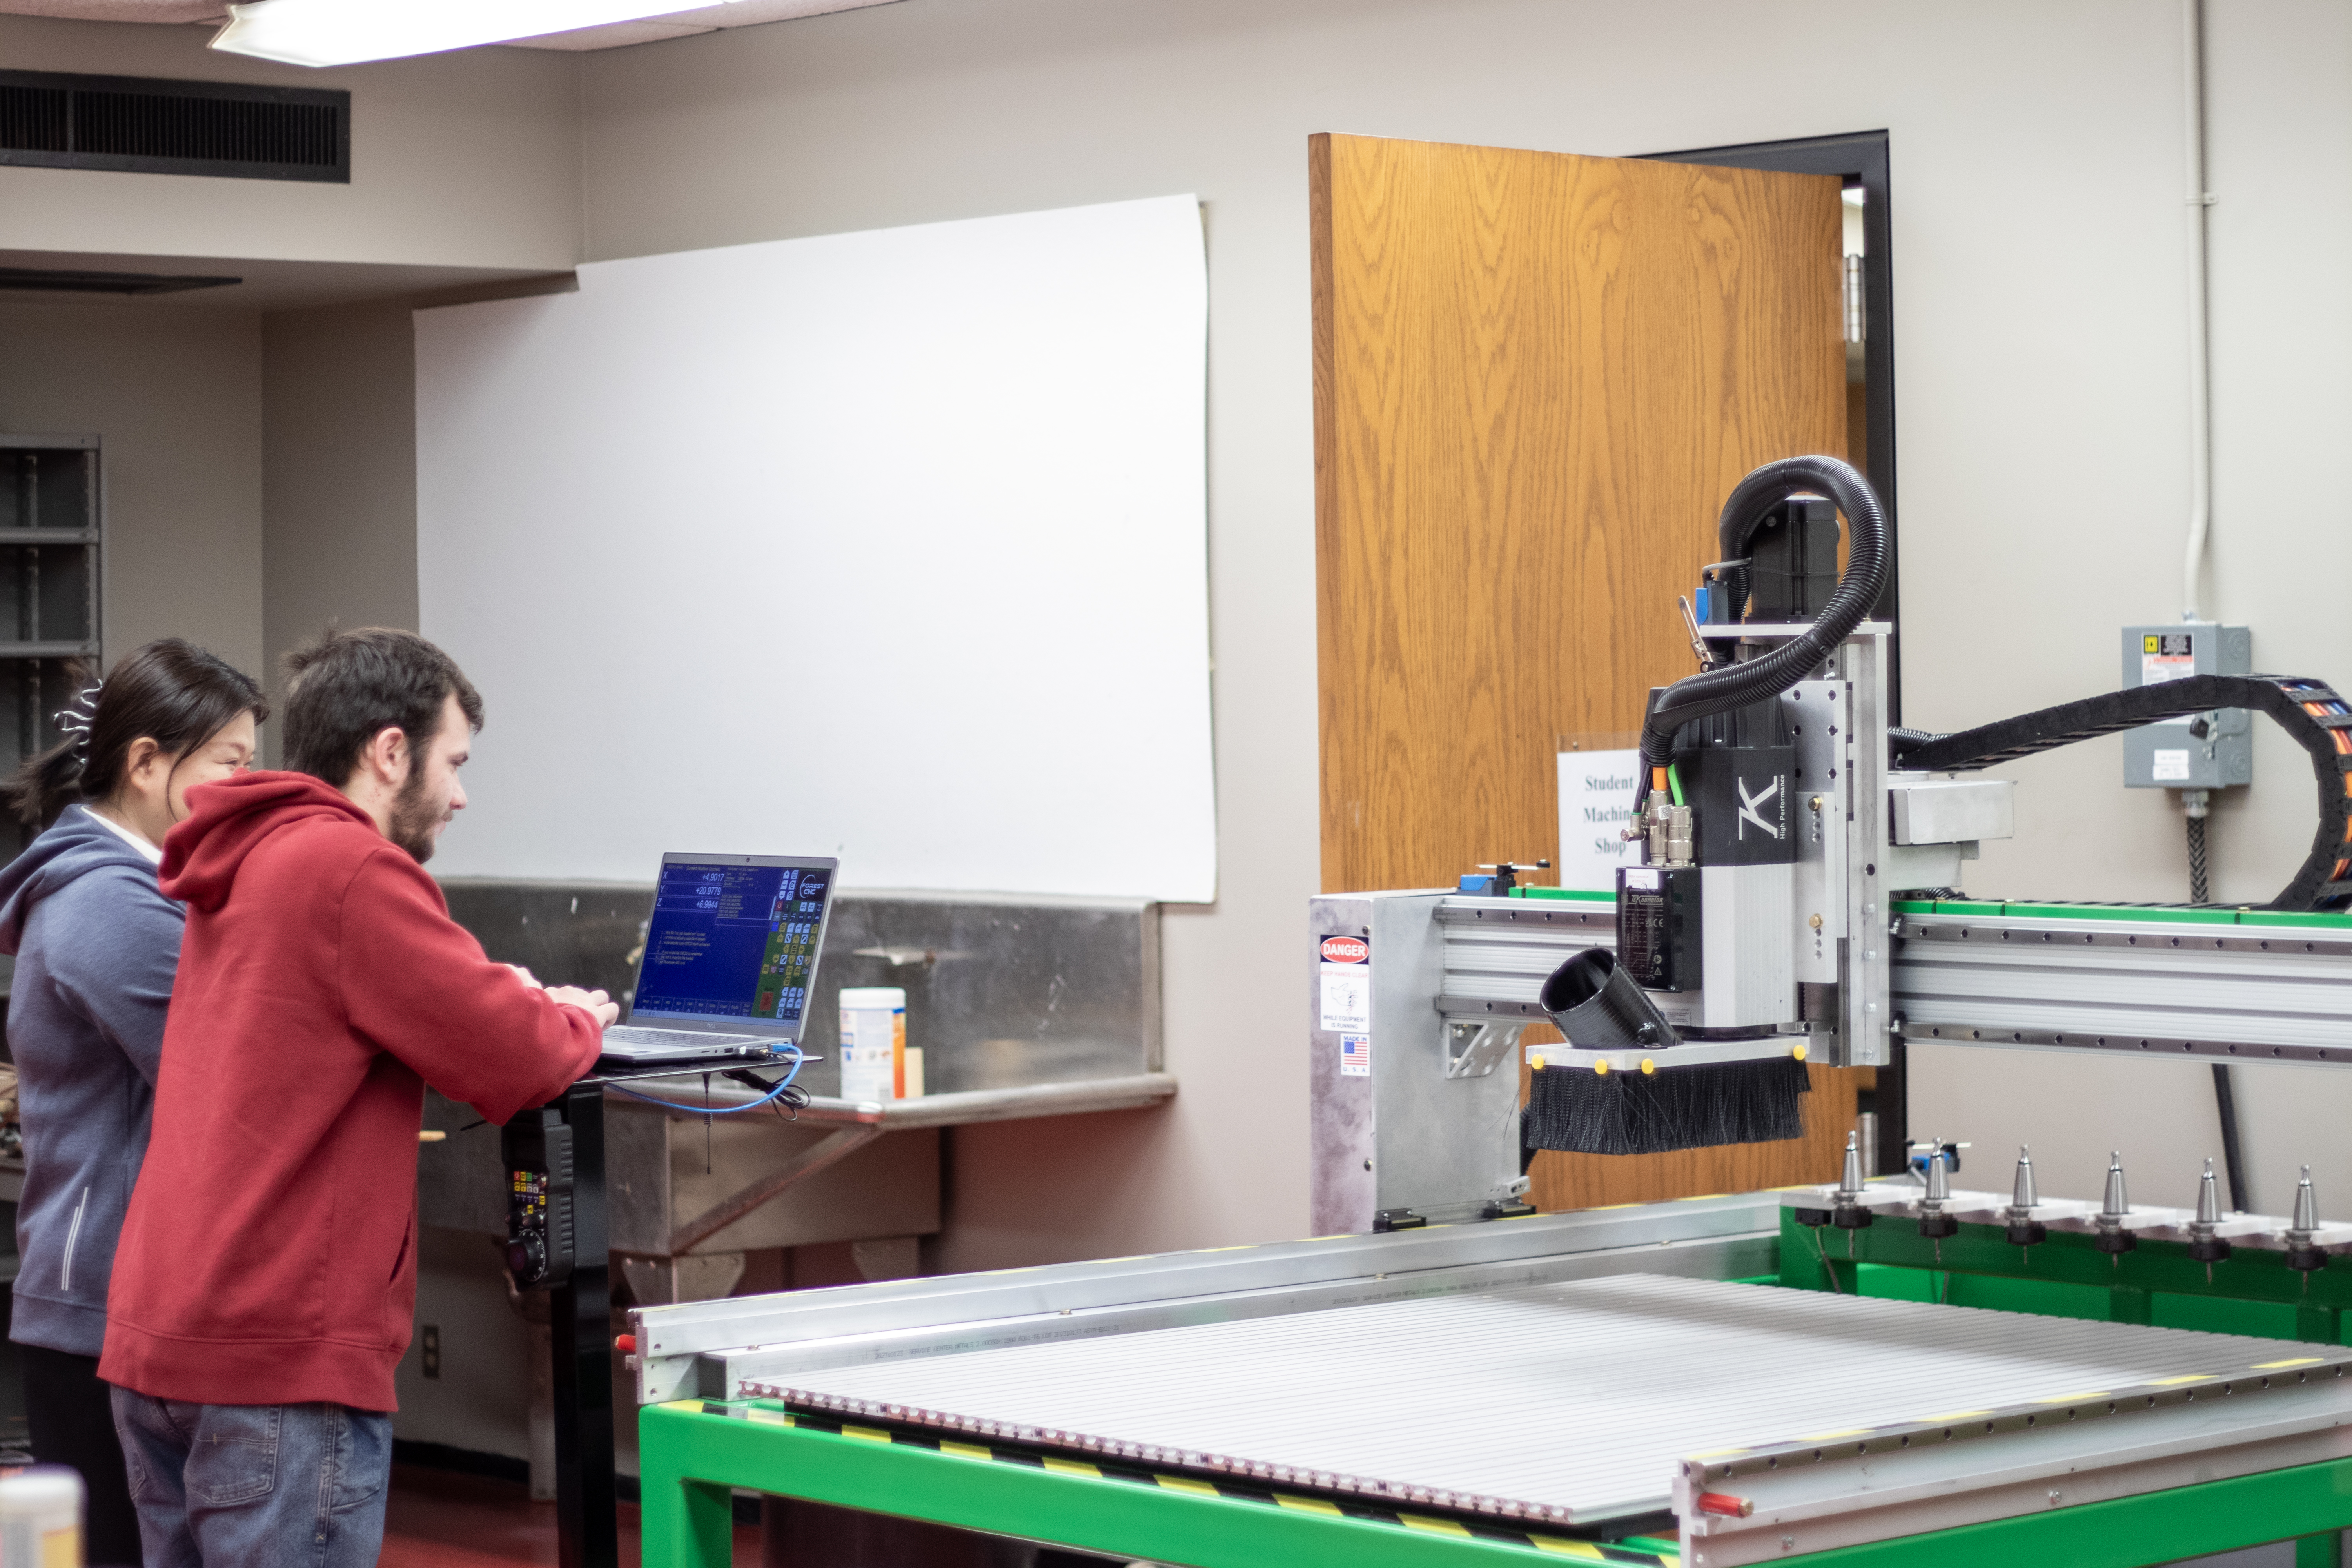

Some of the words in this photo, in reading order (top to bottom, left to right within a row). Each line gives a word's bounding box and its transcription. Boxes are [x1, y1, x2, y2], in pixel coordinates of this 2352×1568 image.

[1585, 775, 1633, 791] Student
[1583, 804, 1630, 823] Machin
[1595, 838, 1626, 857] Shop
[702, 873, 724, 882] +4.9017
[660, 884, 665, 893] Y
[696, 887, 721, 895] +20.9779
[657, 898, 661, 906] Z
[696, 900, 718, 909] +6.9944
[1323, 943, 1365, 956] DANGER
[909, 1346, 931, 1355] SERVICE
[933, 1344, 953, 1352] CENTER
[955, 1342, 974, 1350] METALS
